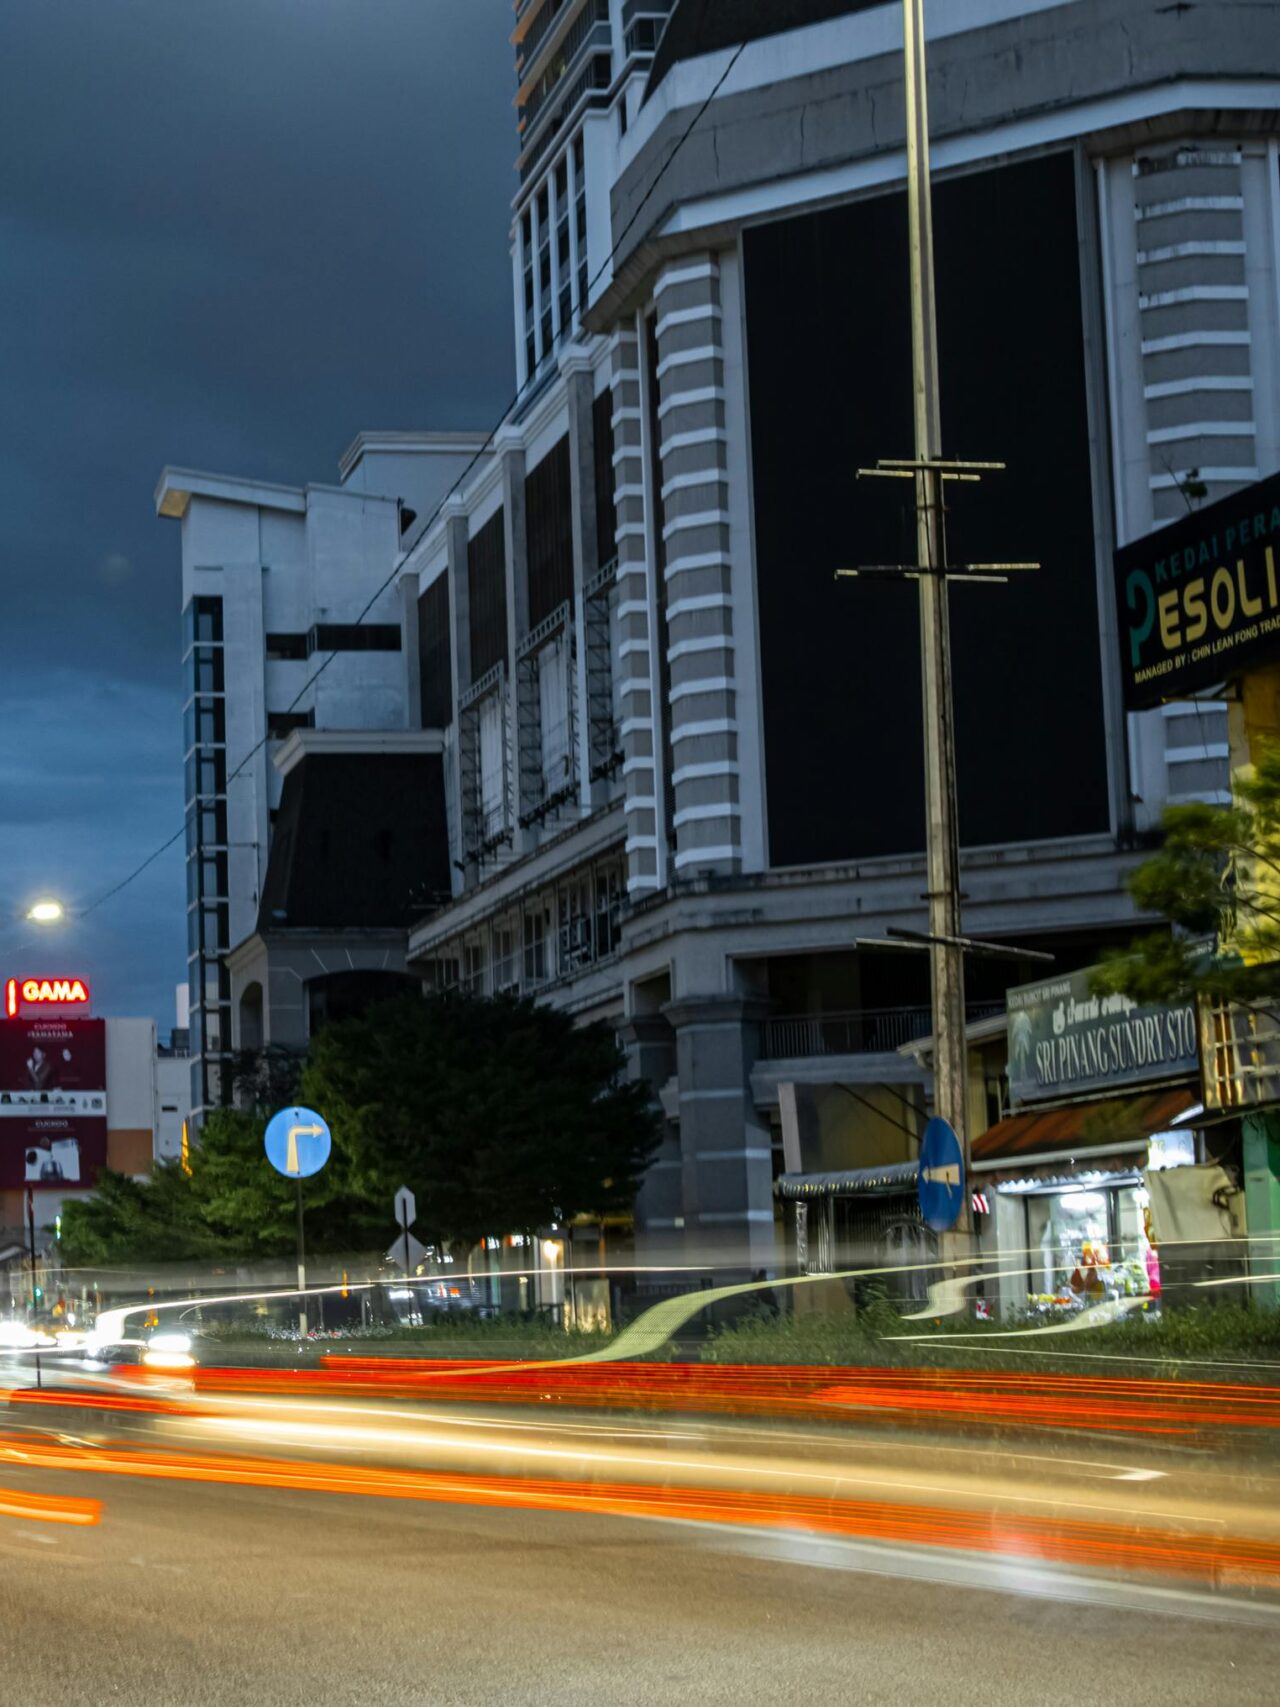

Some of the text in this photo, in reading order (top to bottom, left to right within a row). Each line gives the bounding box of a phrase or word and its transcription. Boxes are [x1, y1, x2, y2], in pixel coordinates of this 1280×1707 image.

[1154, 534, 1219, 584] KEDAI
[1134, 658, 1173, 684] MANAGED
[1175, 653, 1186, 669] BY
[1191, 644, 1211, 661] CHIN
[1234, 624, 1258, 644] FONG
[22, 980, 87, 1002] GAMA
[1035, 1039, 1057, 1085] SRI
[1059, 1028, 1108, 1081] PINANG
[1109, 1013, 1164, 1071] SUNDRY
